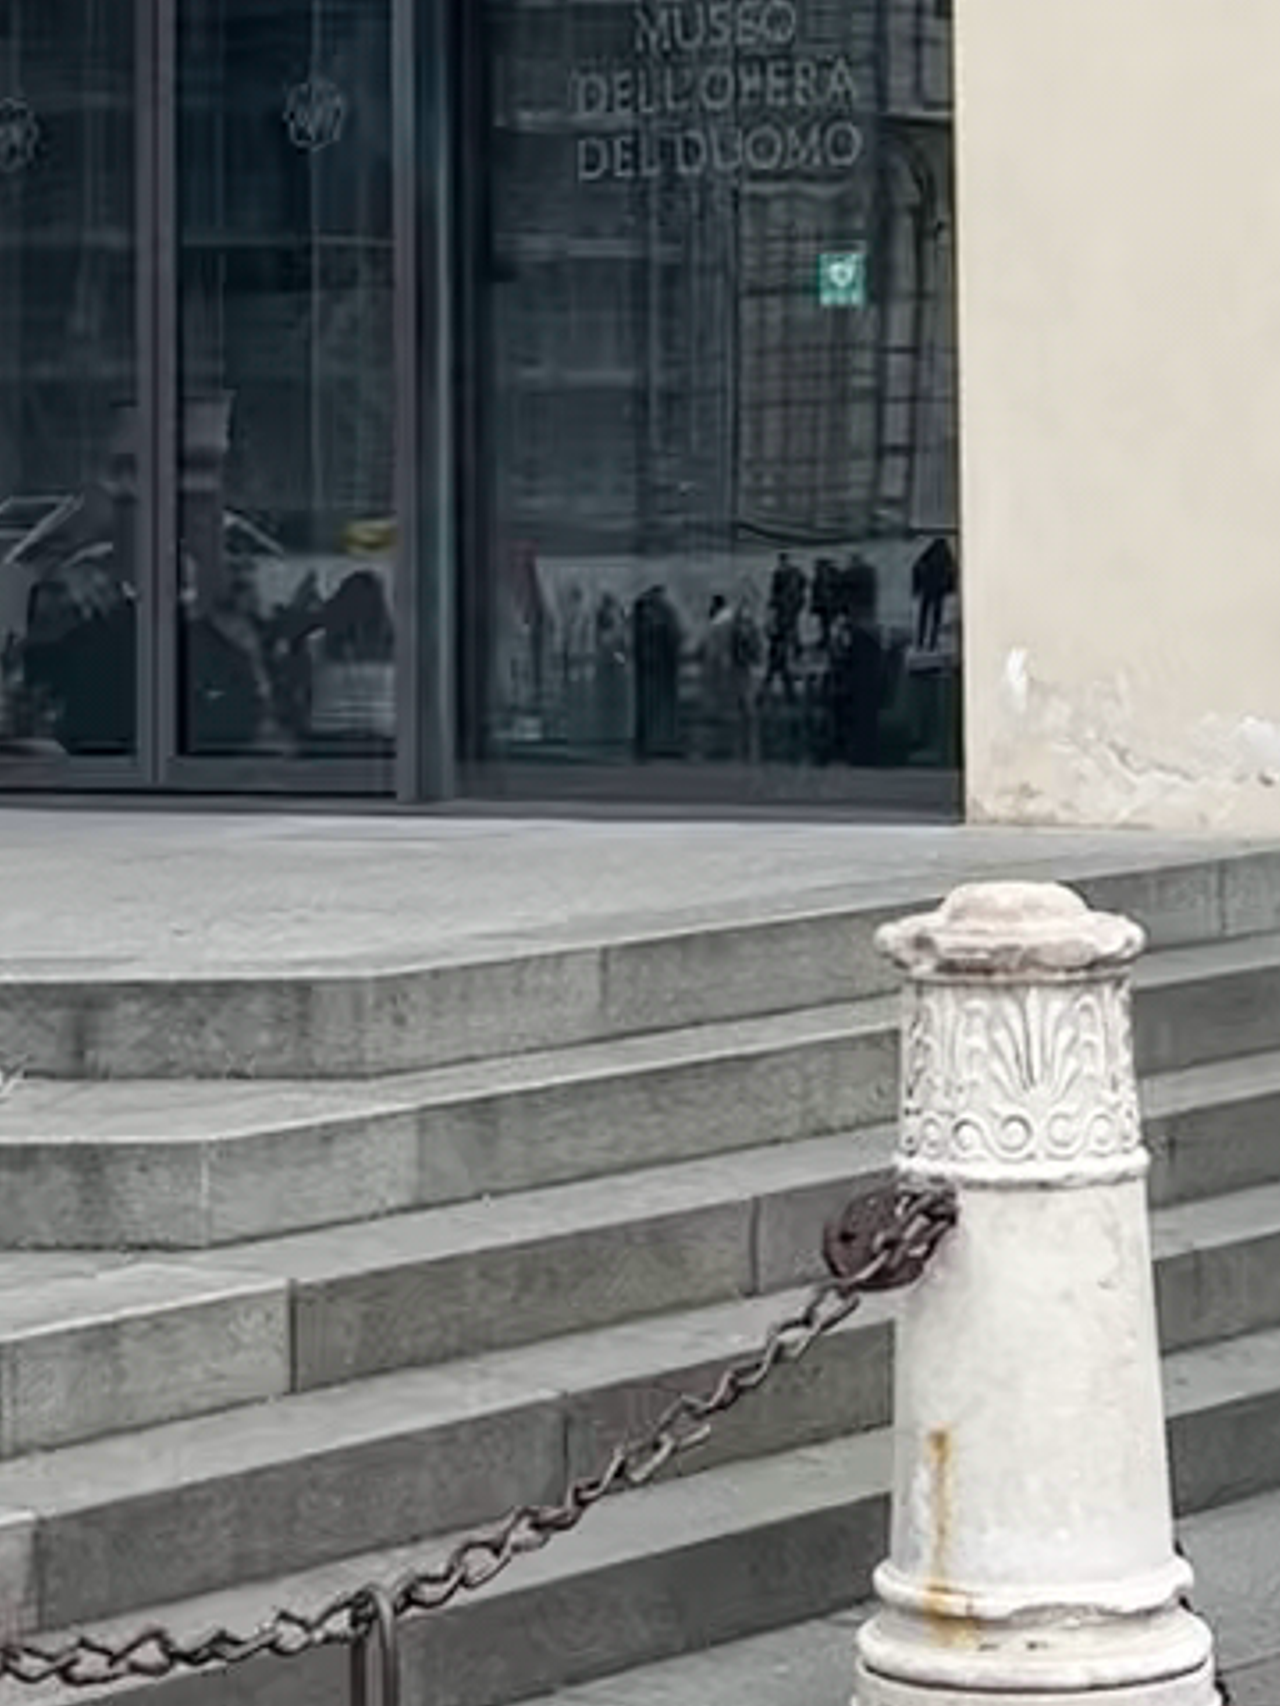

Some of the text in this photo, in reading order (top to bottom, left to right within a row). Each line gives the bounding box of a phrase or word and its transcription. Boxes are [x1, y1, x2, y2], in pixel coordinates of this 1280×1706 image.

[576, 57, 859, 115] DELL'OPERA
[576, 121, 864, 183] DEL DUOMO
